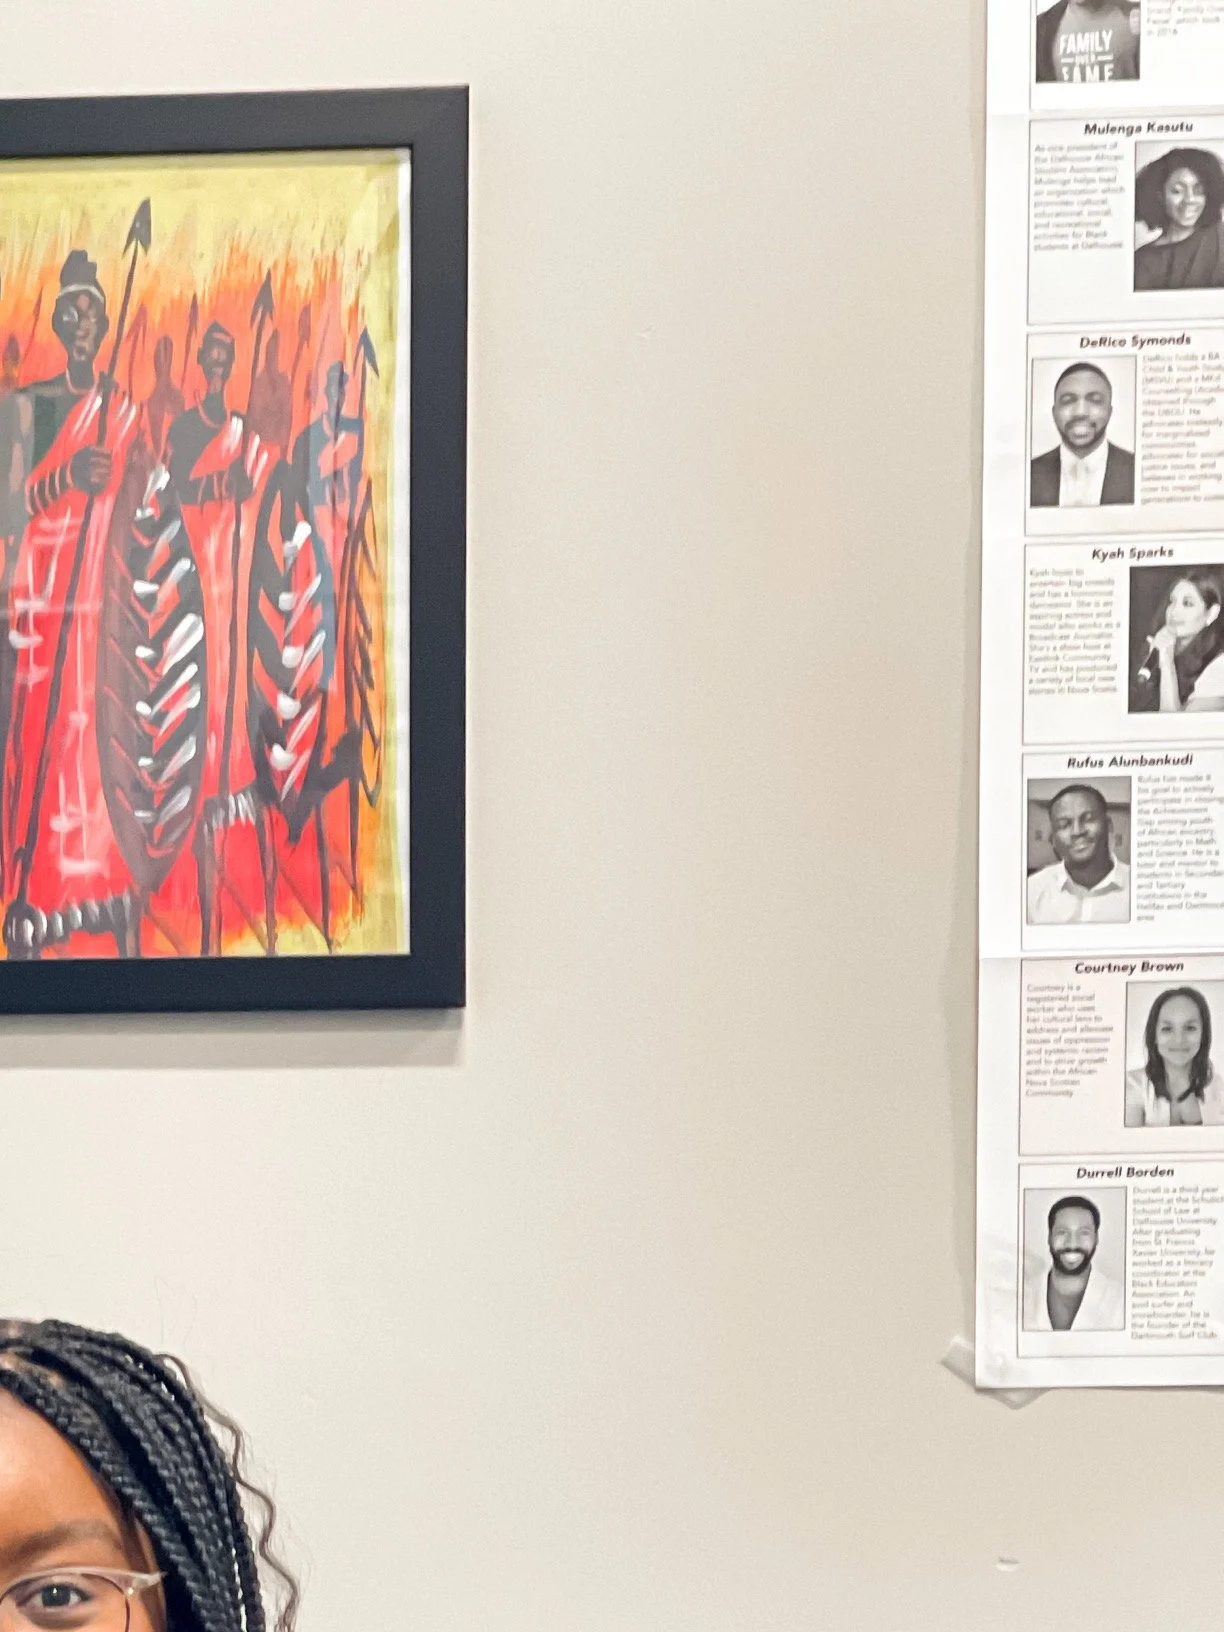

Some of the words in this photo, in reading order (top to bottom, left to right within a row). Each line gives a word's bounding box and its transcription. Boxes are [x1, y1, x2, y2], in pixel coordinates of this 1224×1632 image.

[1060, 30, 1112, 54] FAMILY
[1084, 124, 1142, 136] Mulenga
[1147, 122, 1193, 133] Kasutu
[1080, 336, 1126, 348] DeRico
[1132, 334, 1191, 350] Symonds
[1092, 548, 1124, 562] Kyah
[1129, 547, 1174, 560] Sparks
[1067, 757, 1104, 768] Rufus
[1075, 962, 1137, 976] Courtney
[1141, 961, 1184, 972] Brown
[1076, 1167, 1122, 1178] Durrell
[1126, 1166, 1174, 1177] Borden
